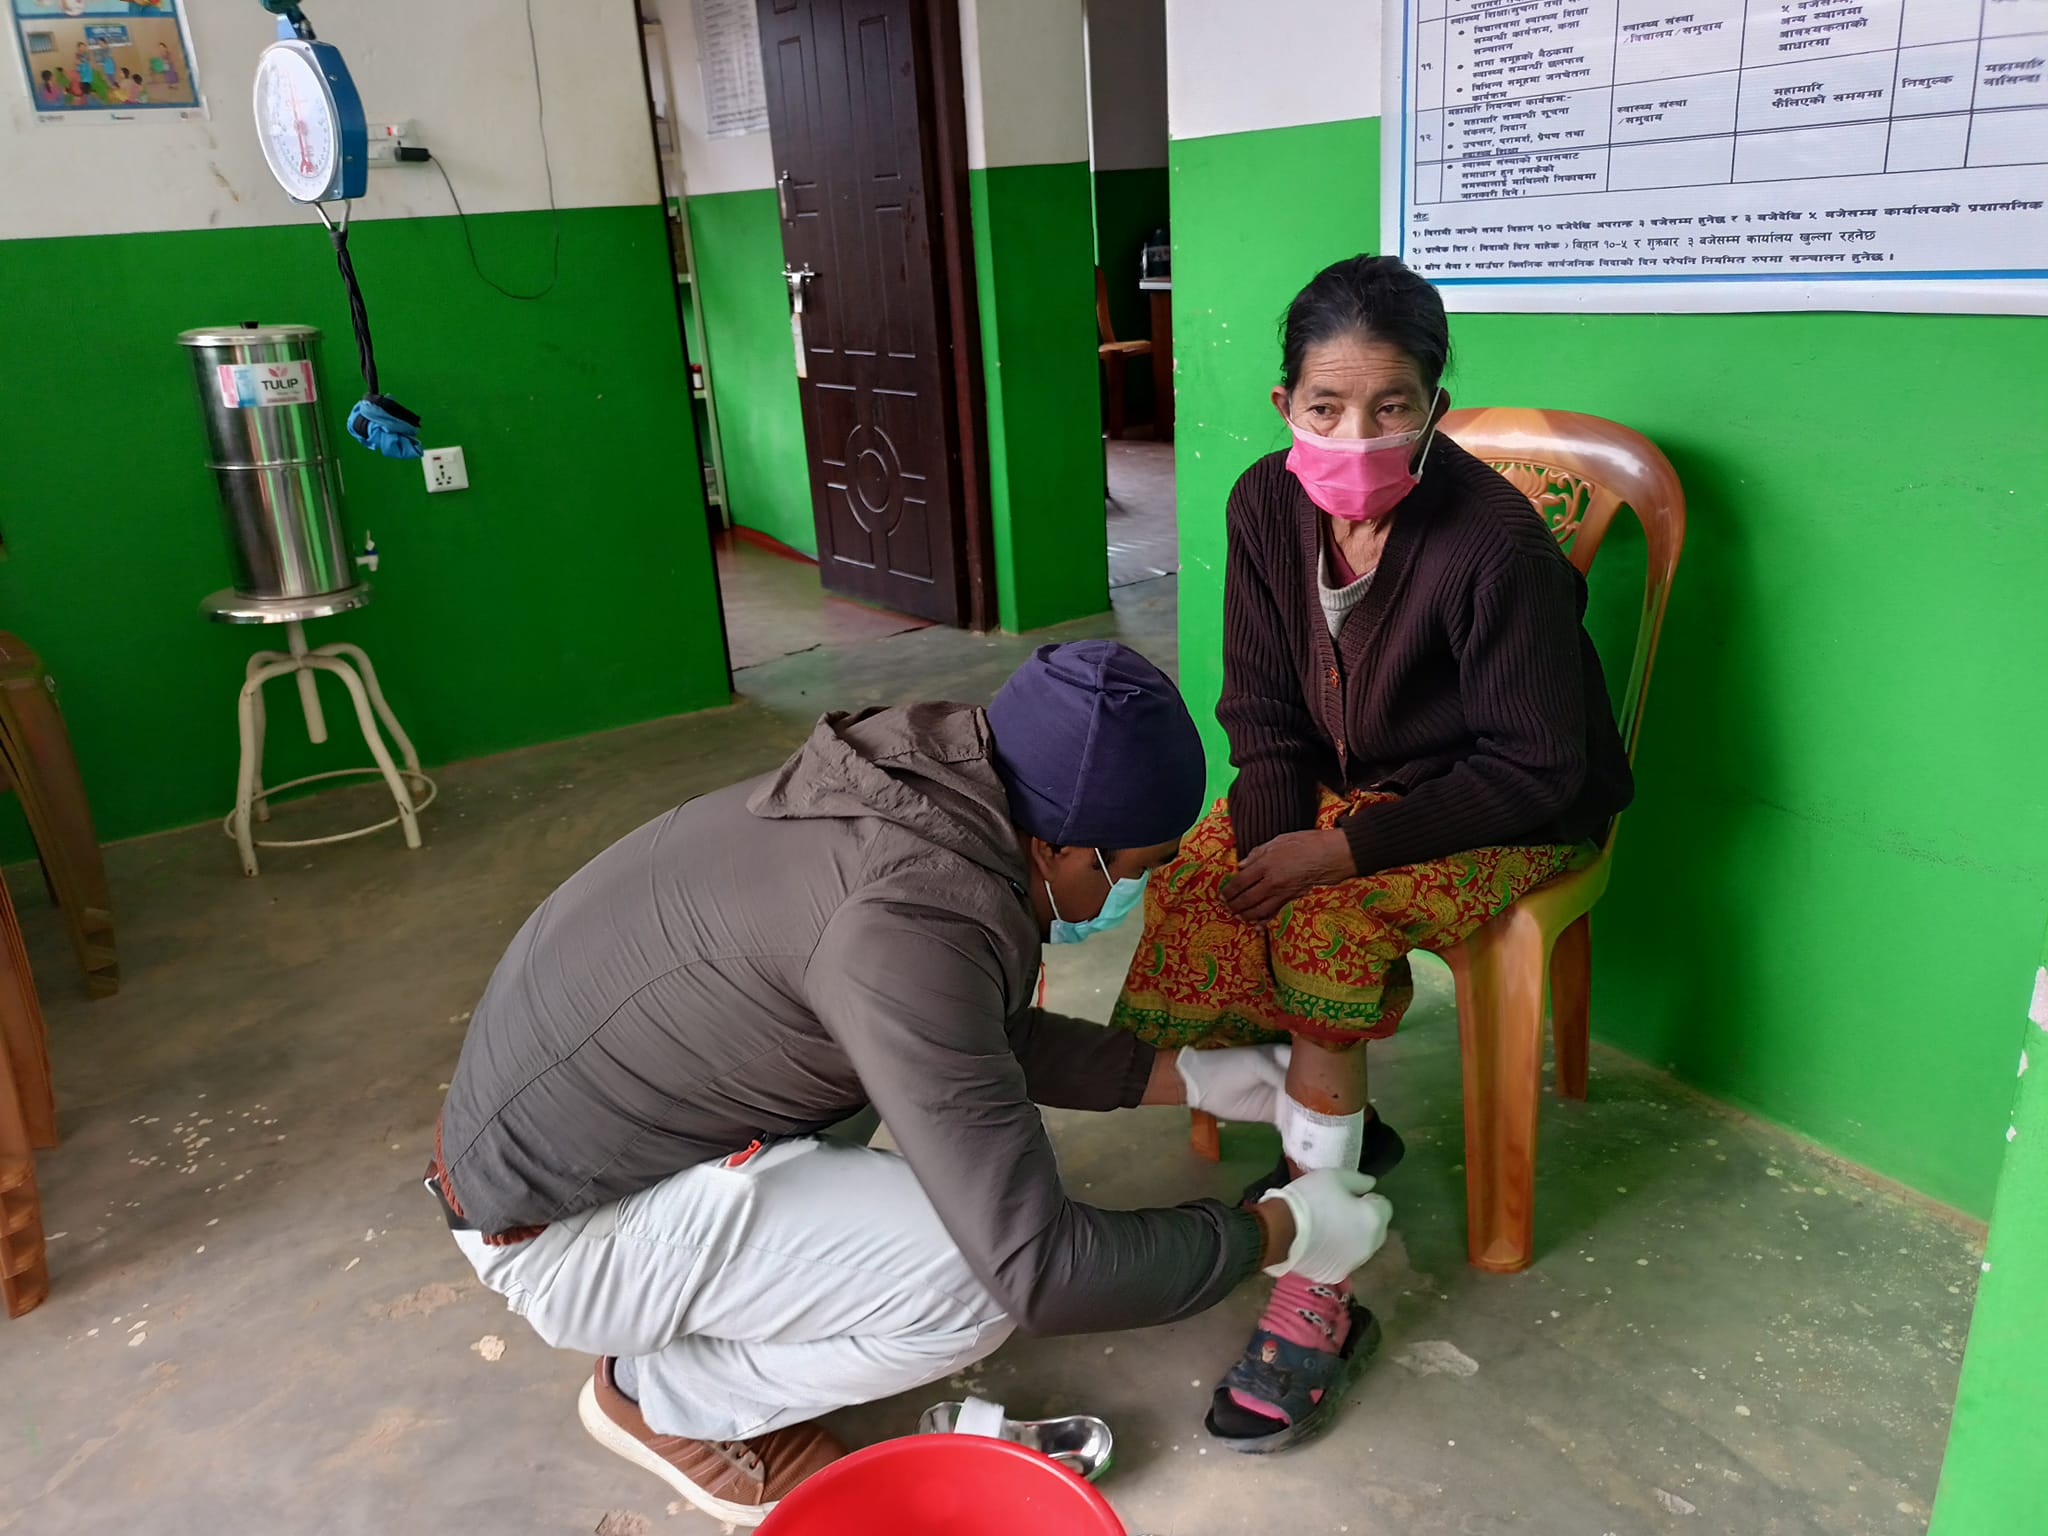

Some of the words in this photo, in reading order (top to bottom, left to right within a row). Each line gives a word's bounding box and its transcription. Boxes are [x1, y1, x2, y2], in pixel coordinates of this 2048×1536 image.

[1781, 15, 1807, 25] अन्य
[1814, 6, 1863, 19] स्थानमा
[1779, 17, 1868, 38] आवश्यकताको
[1778, 37, 1831, 51] आधारमा
[1772, 94, 1826, 108] फैलिएको
[1833, 89, 1883, 102] समयमा
[1774, 82, 1824, 96] महामारि
[1538, 224, 1551, 232] १०
[1699, 215, 1726, 226] हुनेछ
[1884, 203, 1960, 216] कार्यालयको
[1968, 200, 2043, 212] प्रशासनिक
[1634, 239, 1641, 248] र
[1688, 237, 1694, 247] ३
[1746, 232, 1793, 243] कार्यालय
[1800, 232, 1832, 246] खुल्ला
[1840, 229, 1876, 242] रहनेछ
[1702, 255, 1746, 264] नियमित
[1852, 251, 1884, 263] हुनेछ
[261, 379, 298, 390] TULIP
